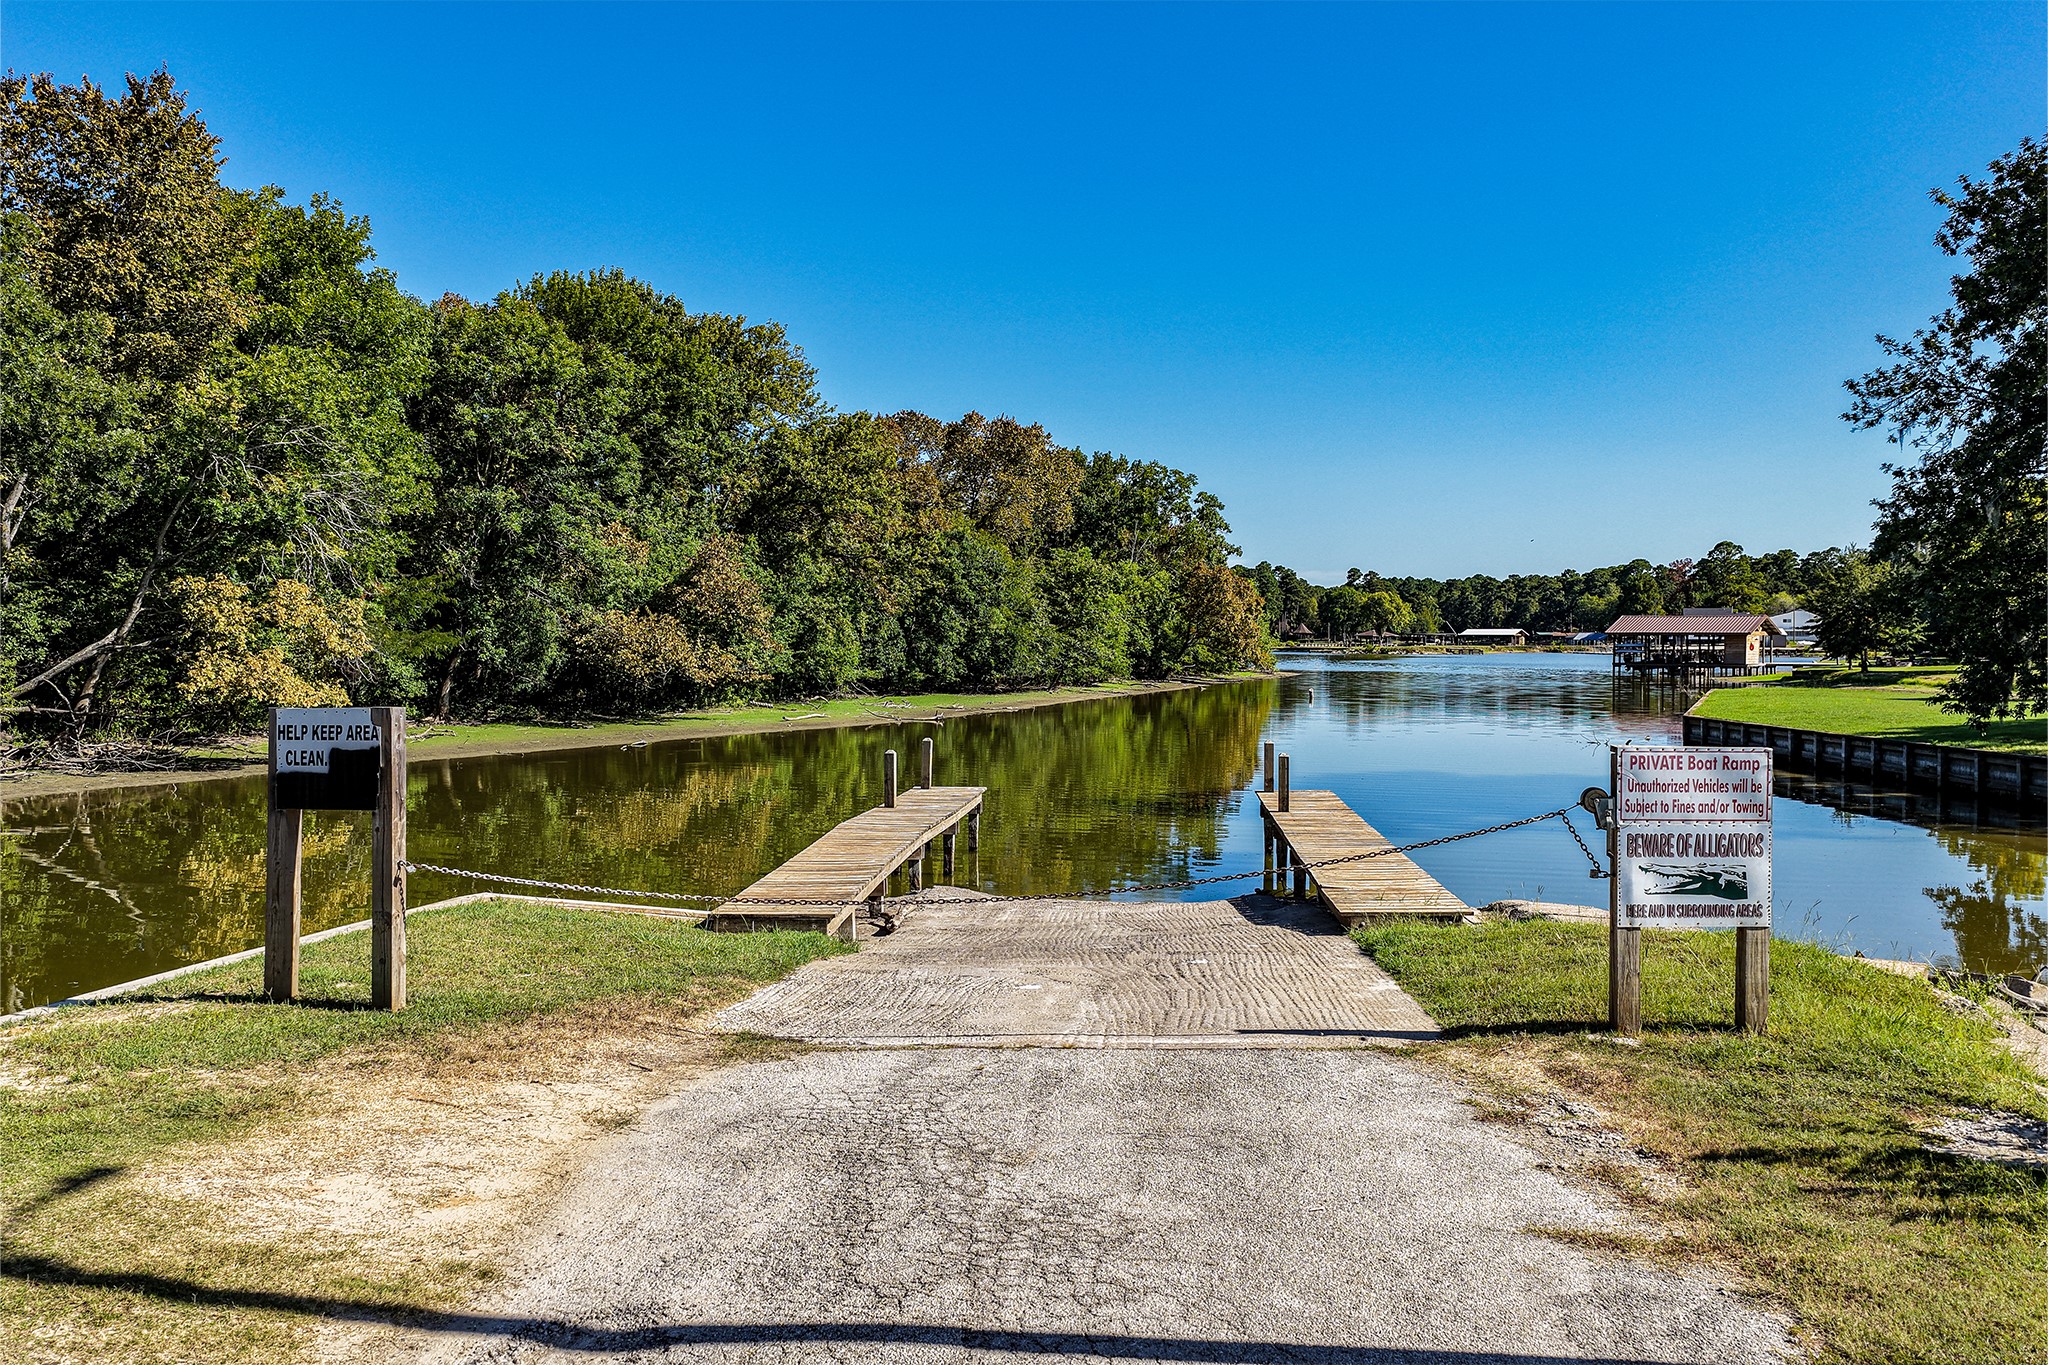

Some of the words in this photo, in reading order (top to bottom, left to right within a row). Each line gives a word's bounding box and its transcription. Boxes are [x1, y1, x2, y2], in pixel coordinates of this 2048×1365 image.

[277, 724, 308, 741] HELP
[312, 724, 342, 741] KEEP
[346, 724, 379, 741] AREA
[285, 750, 328, 766] CLEAN.
[1630, 755, 1683, 771] PRIVATE
[1688, 756, 1718, 771] Boat
[1722, 756, 1760, 774] Ramp
[1627, 778, 1690, 793] Unauthorized
[1693, 778, 1729, 793] Vehicles
[1732, 778, 1748, 793] will
[1751, 778, 1762, 793] be
[1625, 799, 1657, 816] Subject
[1660, 800, 1669, 813] to
[1672, 799, 1695, 813] Fines
[1699, 799, 1729, 815] and/or
[1732, 799, 1764, 817] Towing
[1626, 833, 1675, 858] BEWARE
[1676, 833, 1692, 858] OF
[1694, 833, 1764, 858] ALLIGATORS
[1626, 904, 1647, 918] HERE
[1648, 904, 1665, 918] AND
[1667, 904, 1675, 918] IN
[1677, 904, 1735, 918] SURROUNDING
[1736, 904, 1763, 918] AREAS
